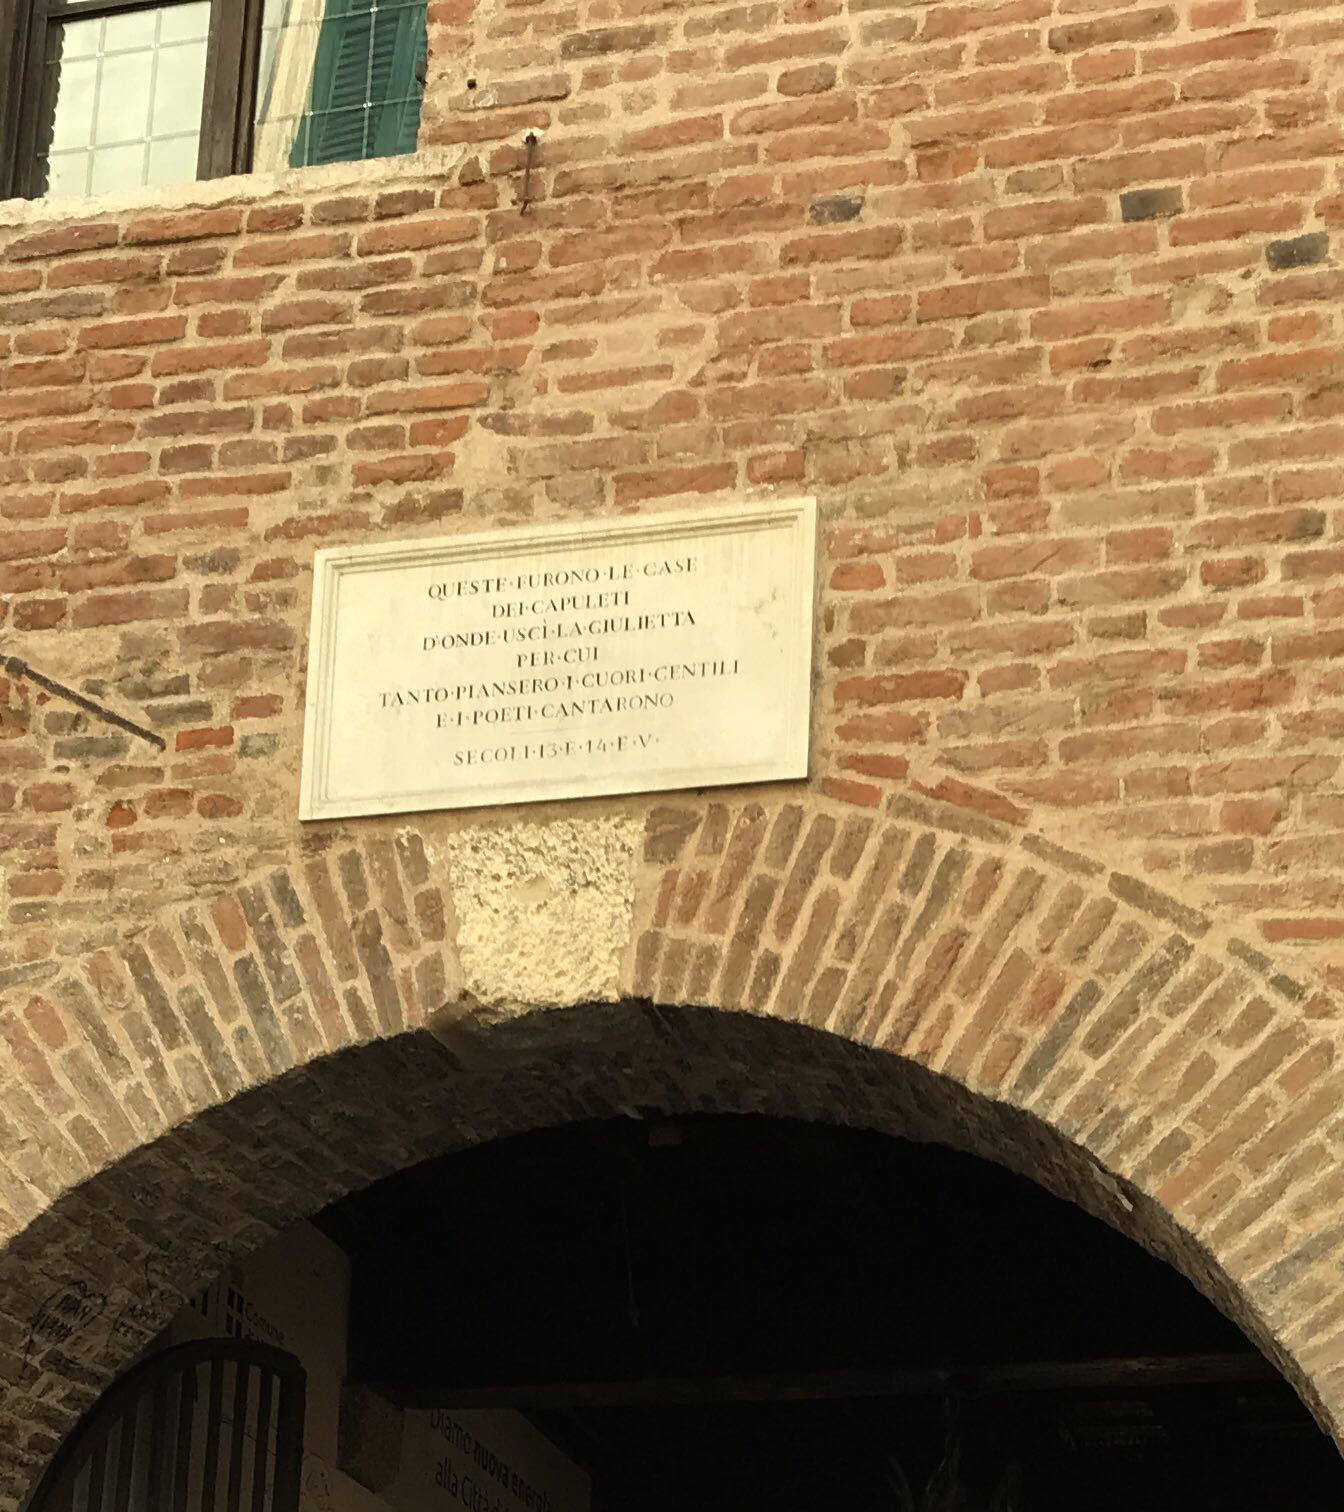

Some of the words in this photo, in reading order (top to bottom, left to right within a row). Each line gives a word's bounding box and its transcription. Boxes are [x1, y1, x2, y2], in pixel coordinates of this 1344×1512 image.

[516, 567, 600, 589] FURONO
[608, 563, 634, 581] LE
[643, 557, 697, 577] CASE
[492, 602, 525, 619] DEI
[531, 591, 630, 616] CAPULETI
[557, 621, 583, 638] LA
[588, 610, 696, 636] GIULIETTA
[516, 650, 555, 668] PER
[564, 646, 599, 663] CUI
[378, 686, 449, 708] TANTO
[455, 675, 558, 702] PIANSERO
[582, 668, 645, 692] CUORI
[654, 659, 740, 682] GENTILI
[472, 705, 533, 725] POETI
[541, 692, 674, 720] CANTARONO
[453, 745, 529, 767] SECOLI
[473, 1439, 509, 1489] nuova
